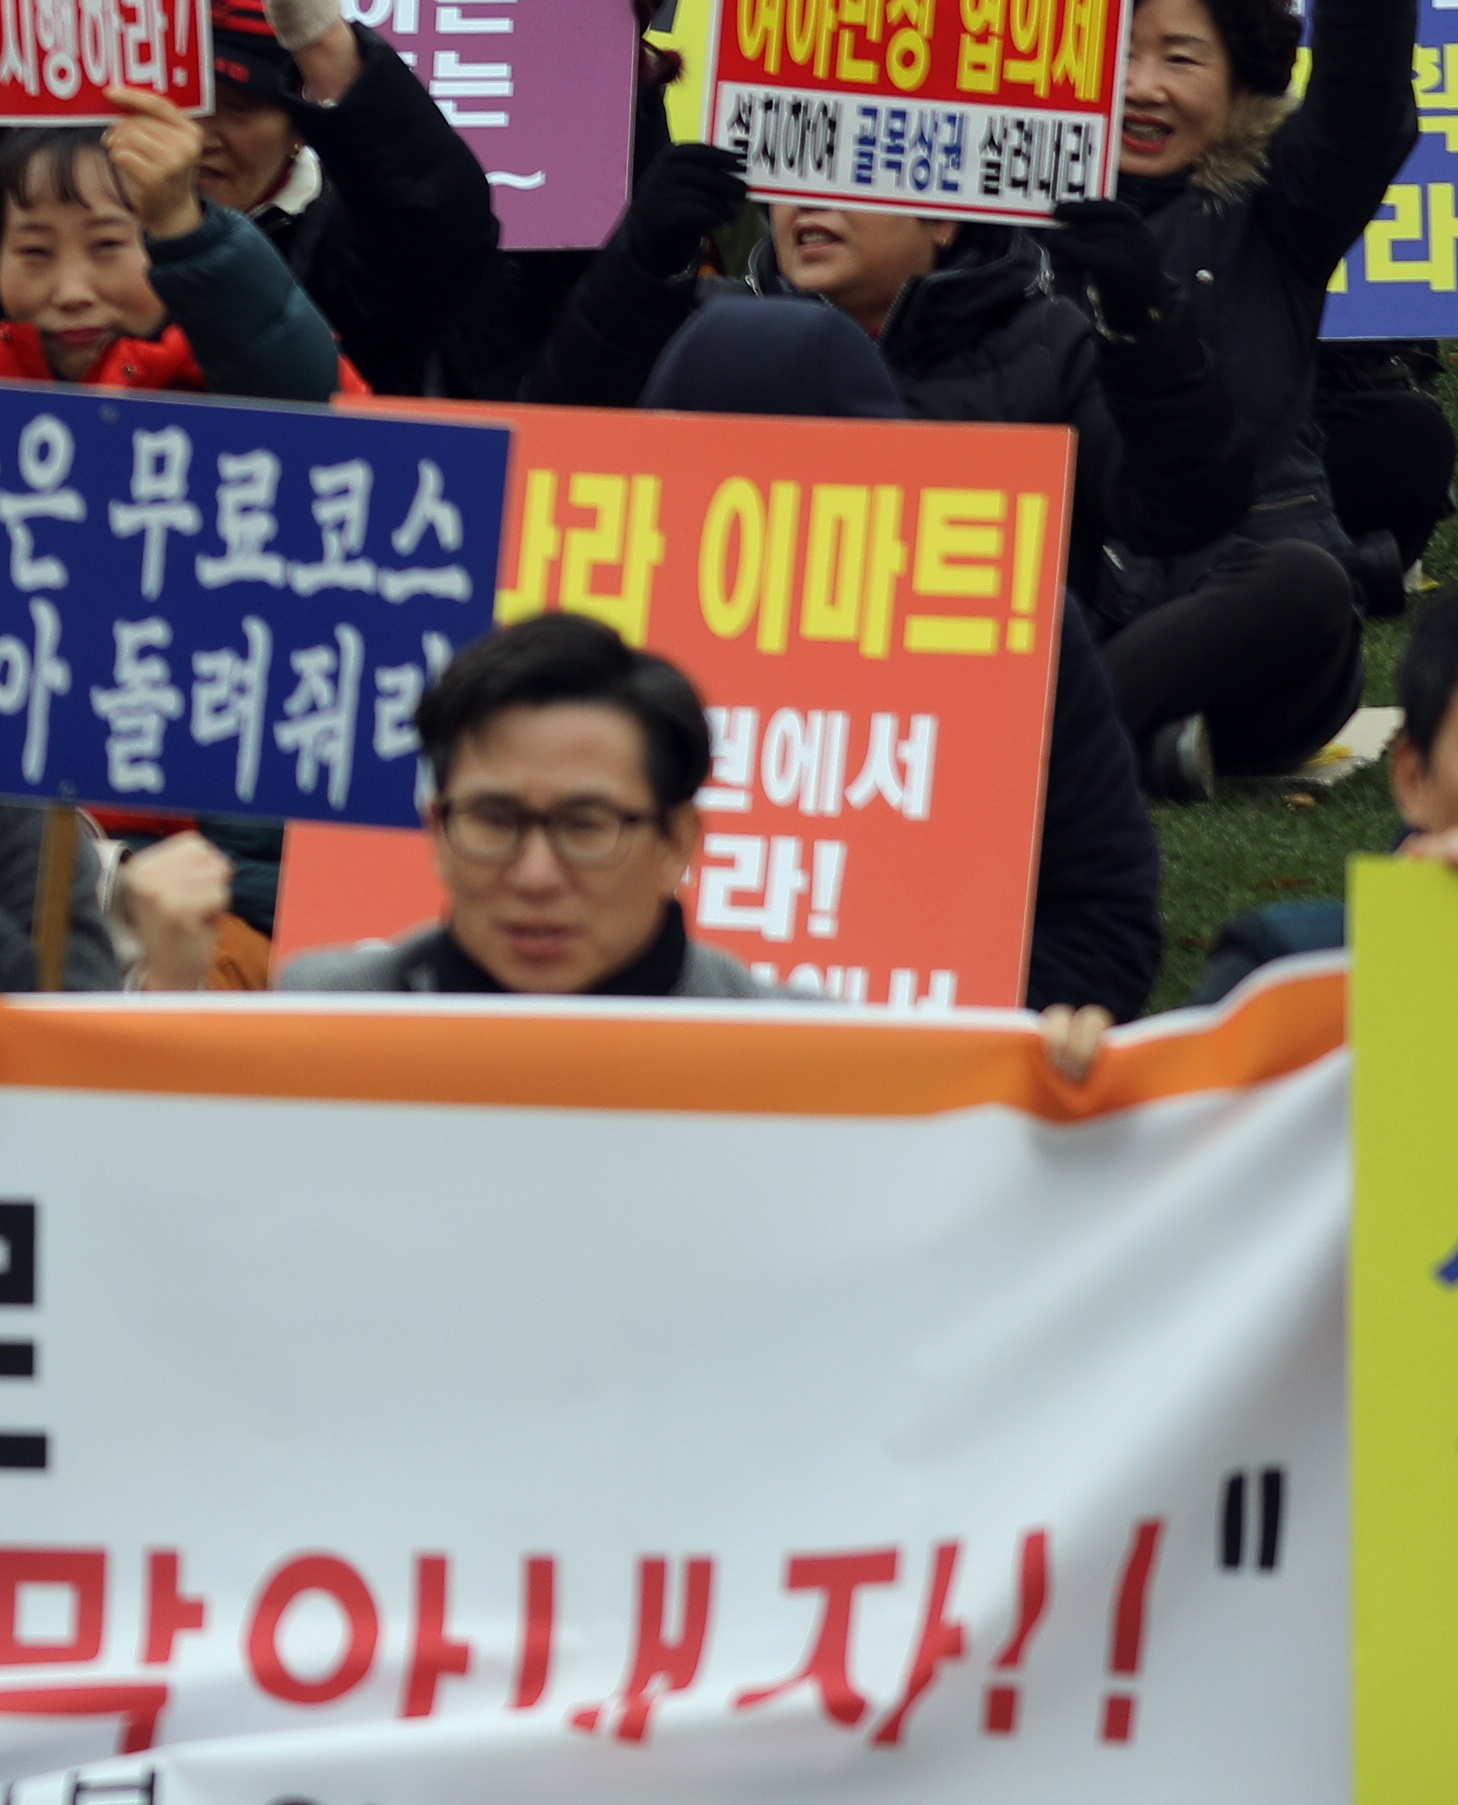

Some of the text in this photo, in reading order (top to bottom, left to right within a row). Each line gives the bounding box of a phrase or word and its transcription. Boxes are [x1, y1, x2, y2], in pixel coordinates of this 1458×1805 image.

[851, 104, 967, 194] 골목상권
[109, 426, 472, 604] 무료코스
[696, 476, 1047, 658] 이마트!
